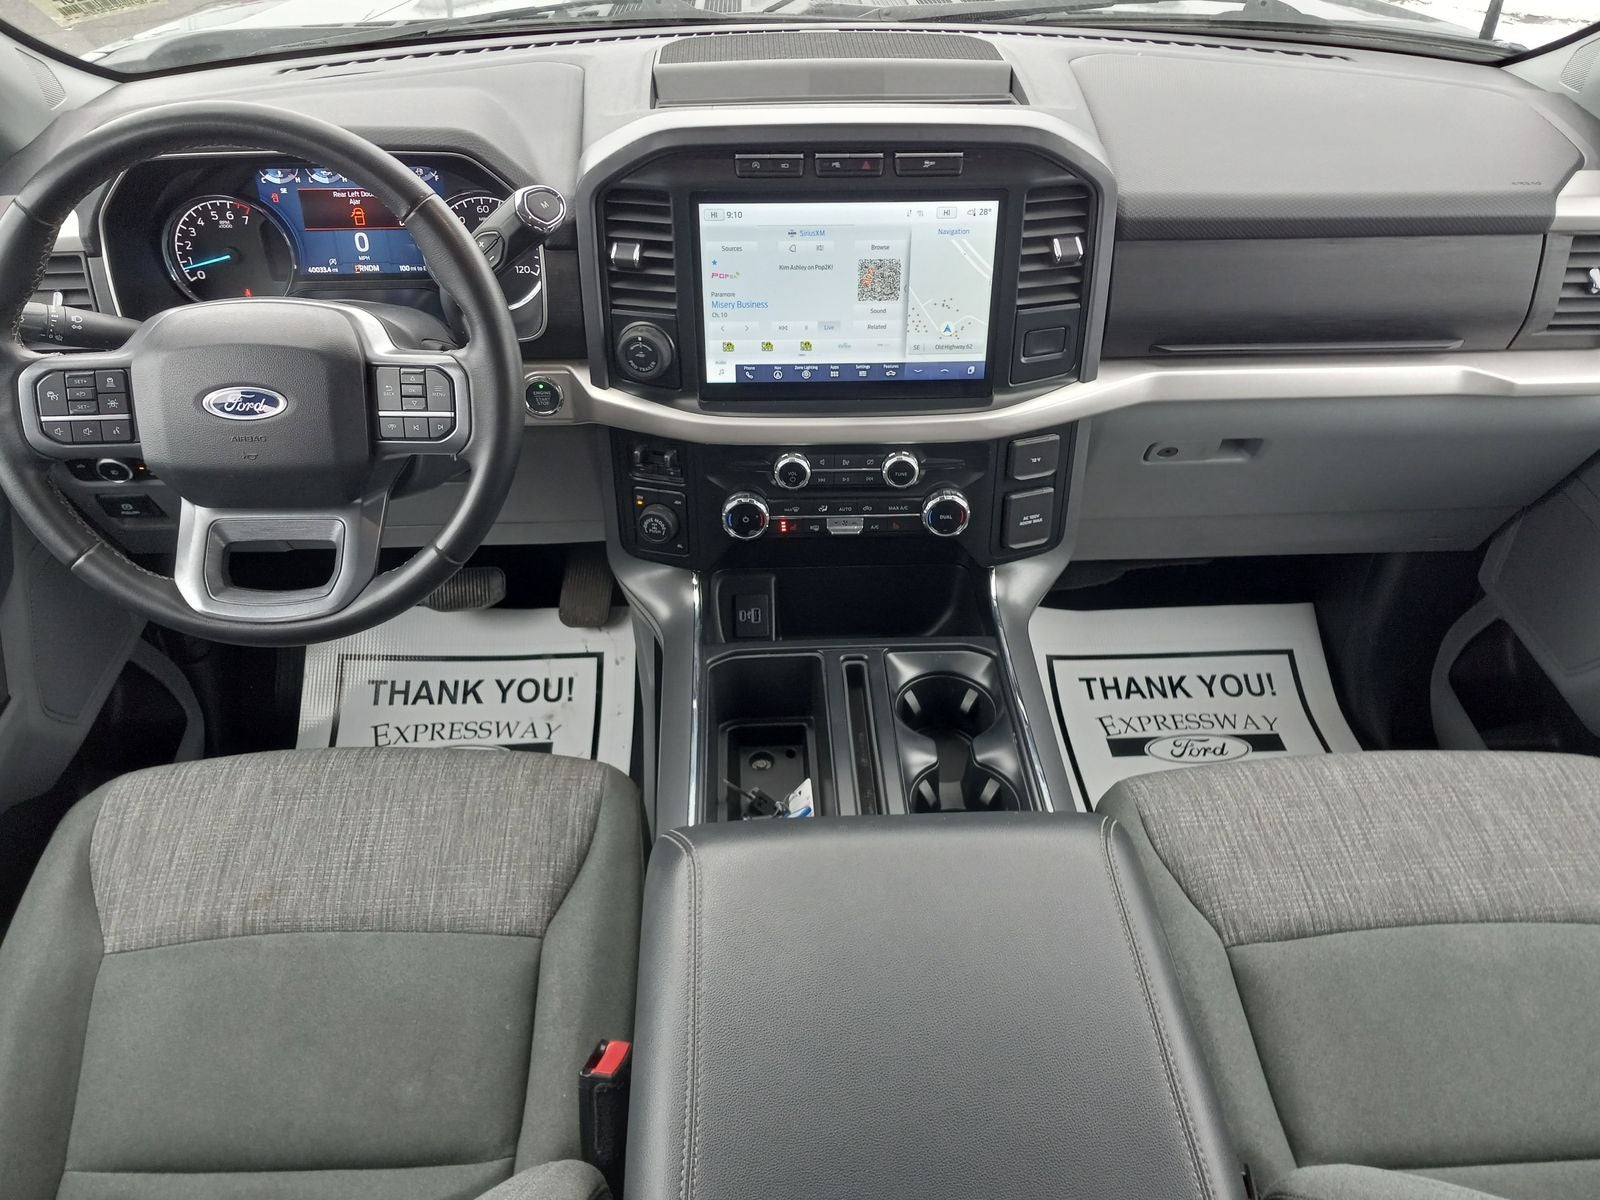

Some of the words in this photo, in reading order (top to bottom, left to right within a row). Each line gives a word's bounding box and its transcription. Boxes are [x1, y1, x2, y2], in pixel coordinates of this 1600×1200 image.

[348, 191, 360, 199] Left
[476, 205, 490, 214] 60
[210, 211, 219, 220] 5
[226, 211, 234, 220] 6
[710, 211, 718, 219] HI
[726, 211, 743, 219] 9:10
[197, 217, 205, 226] 4
[242, 216, 249, 225] 7
[188, 227, 197, 237] 3
[799, 229, 826, 237] SiriusXM
[938, 228, 970, 236] Navigation
[184, 241, 193, 250] 2
[354, 232, 370, 252] 0
[515, 265, 531, 274] 120
[779, 263, 789, 271] Kim
[790, 263, 808, 272] Ashley
[815, 262, 833, 272] Pop2K!
[196, 270, 206, 280] 0
[711, 300, 735, 309] Misery
[736, 299, 769, 309] Business
[867, 323, 887, 331] Related
[945, 343, 966, 352] Highway
[223, 391, 267, 415] Ford
[368, 678, 486, 706] THANK
[496, 676, 575, 703] YOU!
[1079, 675, 1191, 701] THANK
[1196, 672, 1278, 699] YOU!
[1096, 711, 1279, 738] EXPRESSWAY
[370, 720, 562, 747] EXPRESSWAY
[1169, 737, 1229, 759] Ford
